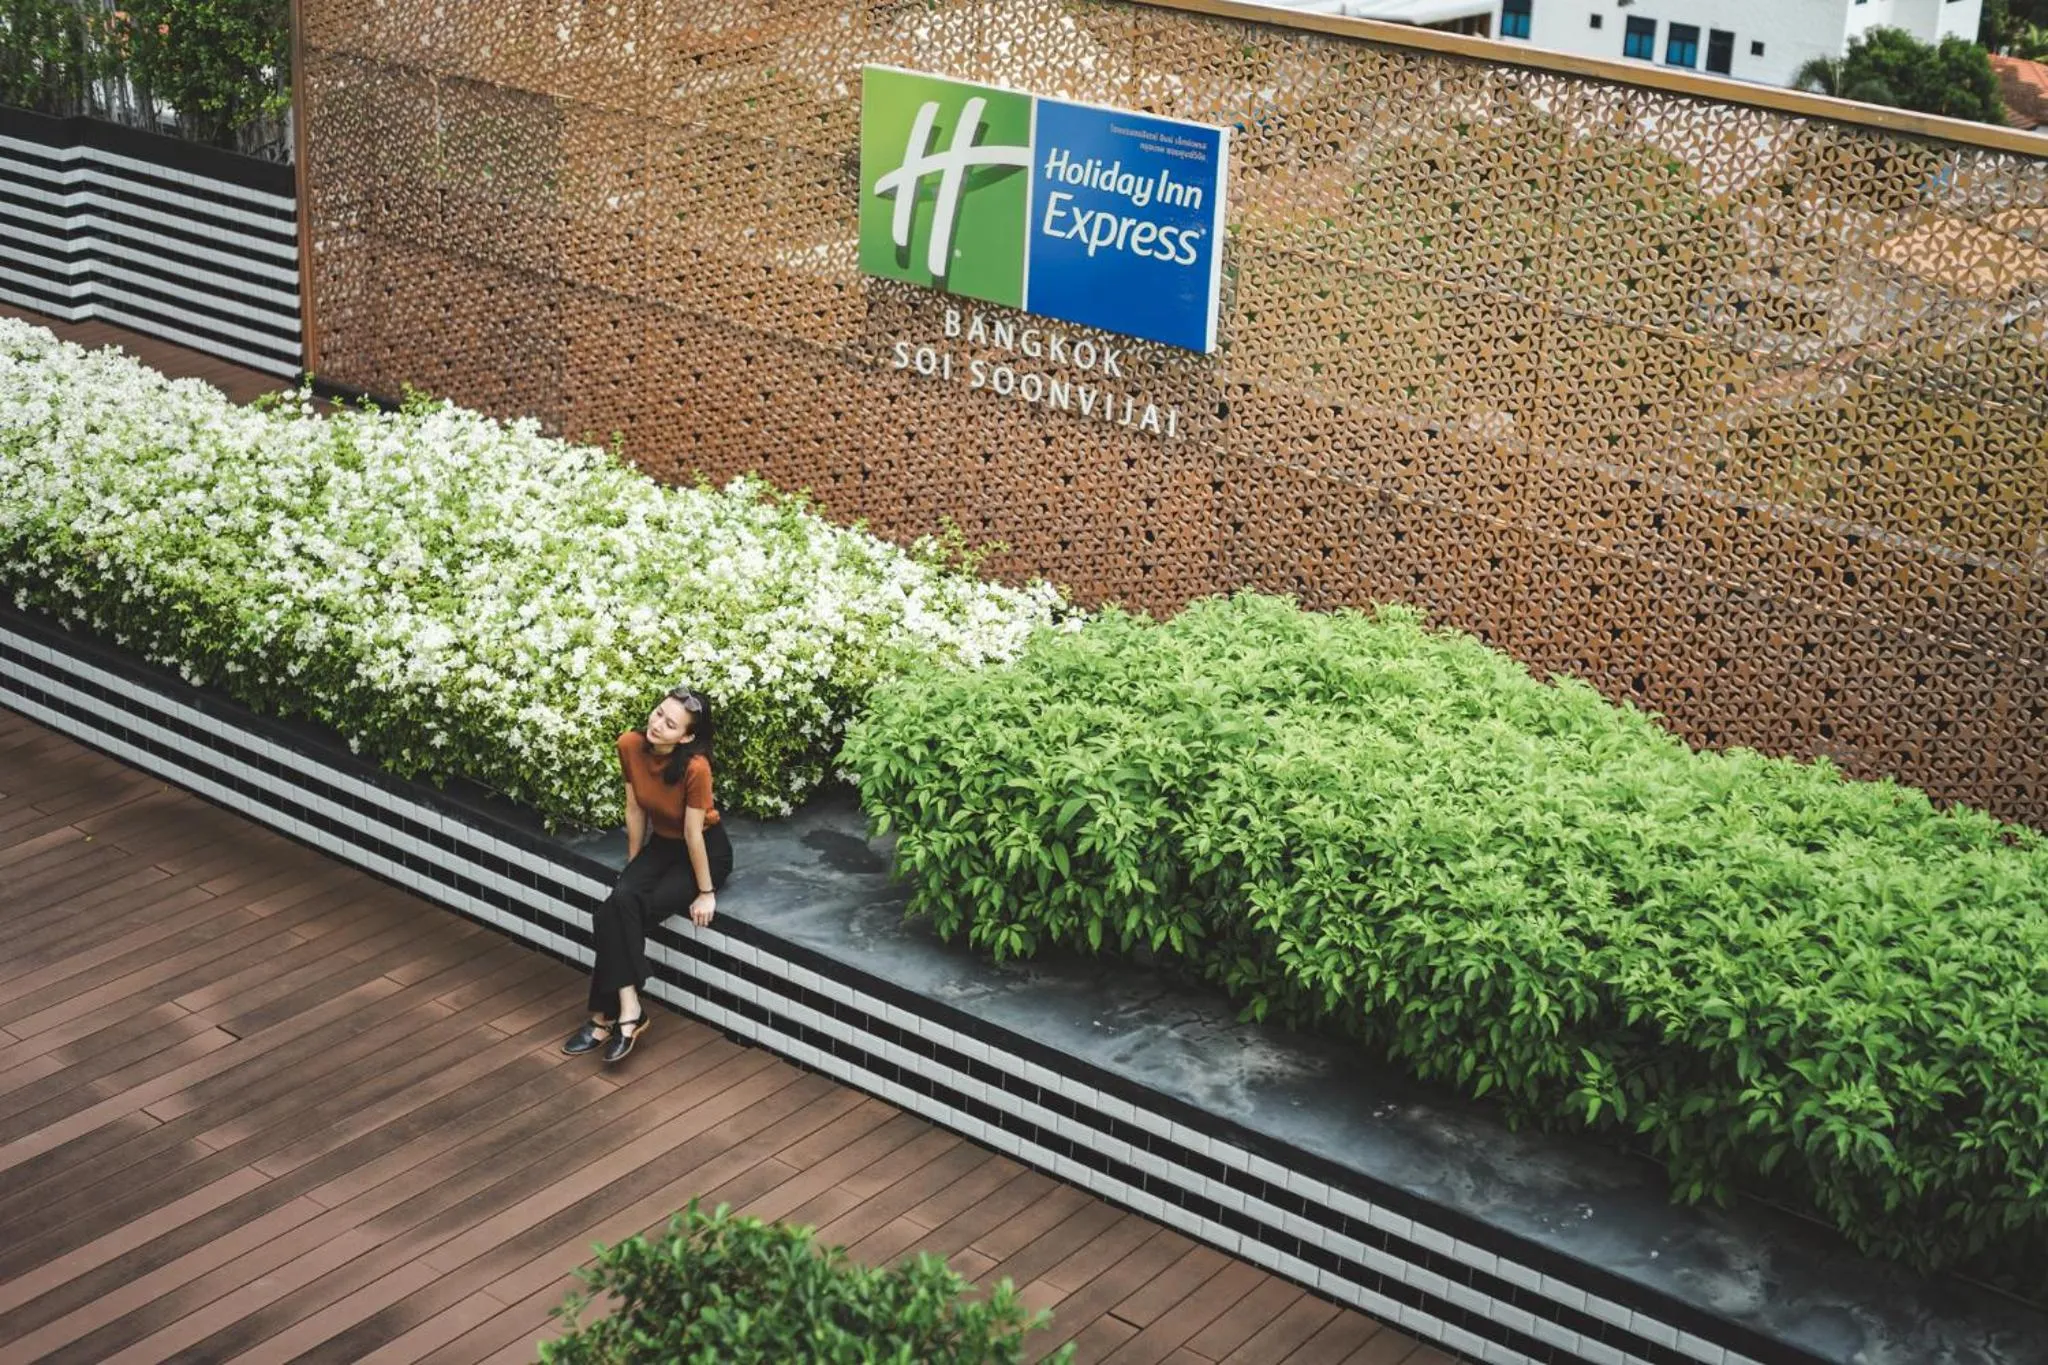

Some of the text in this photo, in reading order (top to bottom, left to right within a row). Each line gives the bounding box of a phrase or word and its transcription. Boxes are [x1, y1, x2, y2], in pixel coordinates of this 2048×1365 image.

[1044, 147, 1203, 210] Holiday Inn
[1043, 190, 1200, 266] Express
[944, 309, 1123, 378] BANGKOK
[893, 341, 1180, 439] SOI SOONVIJAI
